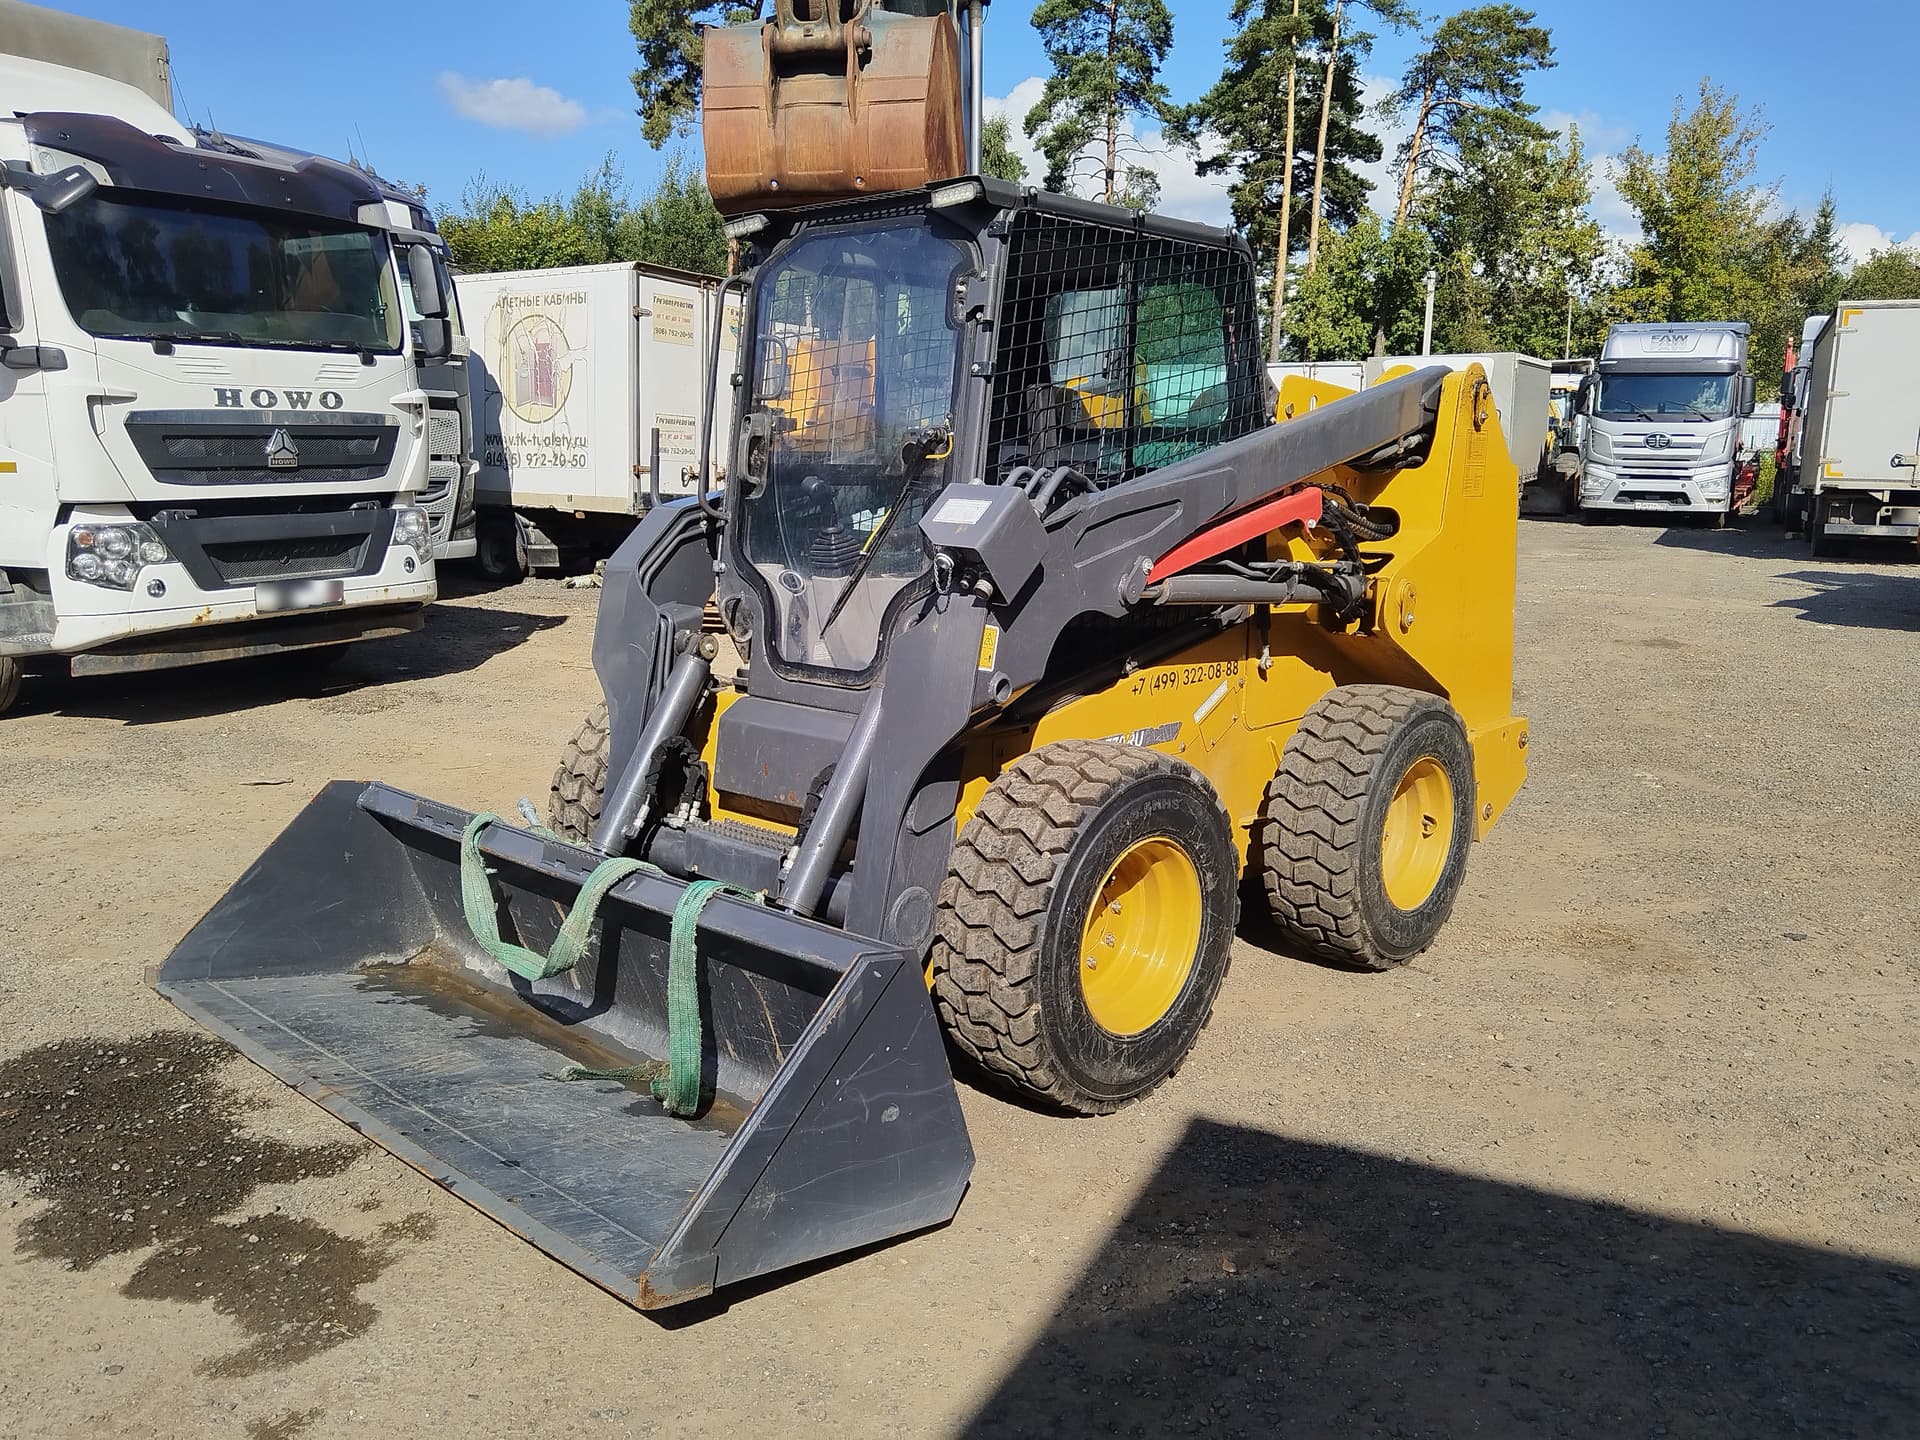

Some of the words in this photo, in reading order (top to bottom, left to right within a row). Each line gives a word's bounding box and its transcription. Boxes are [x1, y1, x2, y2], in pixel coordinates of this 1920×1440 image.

[543, 291, 587, 306] КАБИНЫ
[1651, 334, 1689, 342] FAW
[213, 387, 344, 410] HOWO
[1131, 678, 1146, 695] +7
[1149, 671, 1180, 696] (499)
[1182, 660, 1239, 686] 322-08-88
